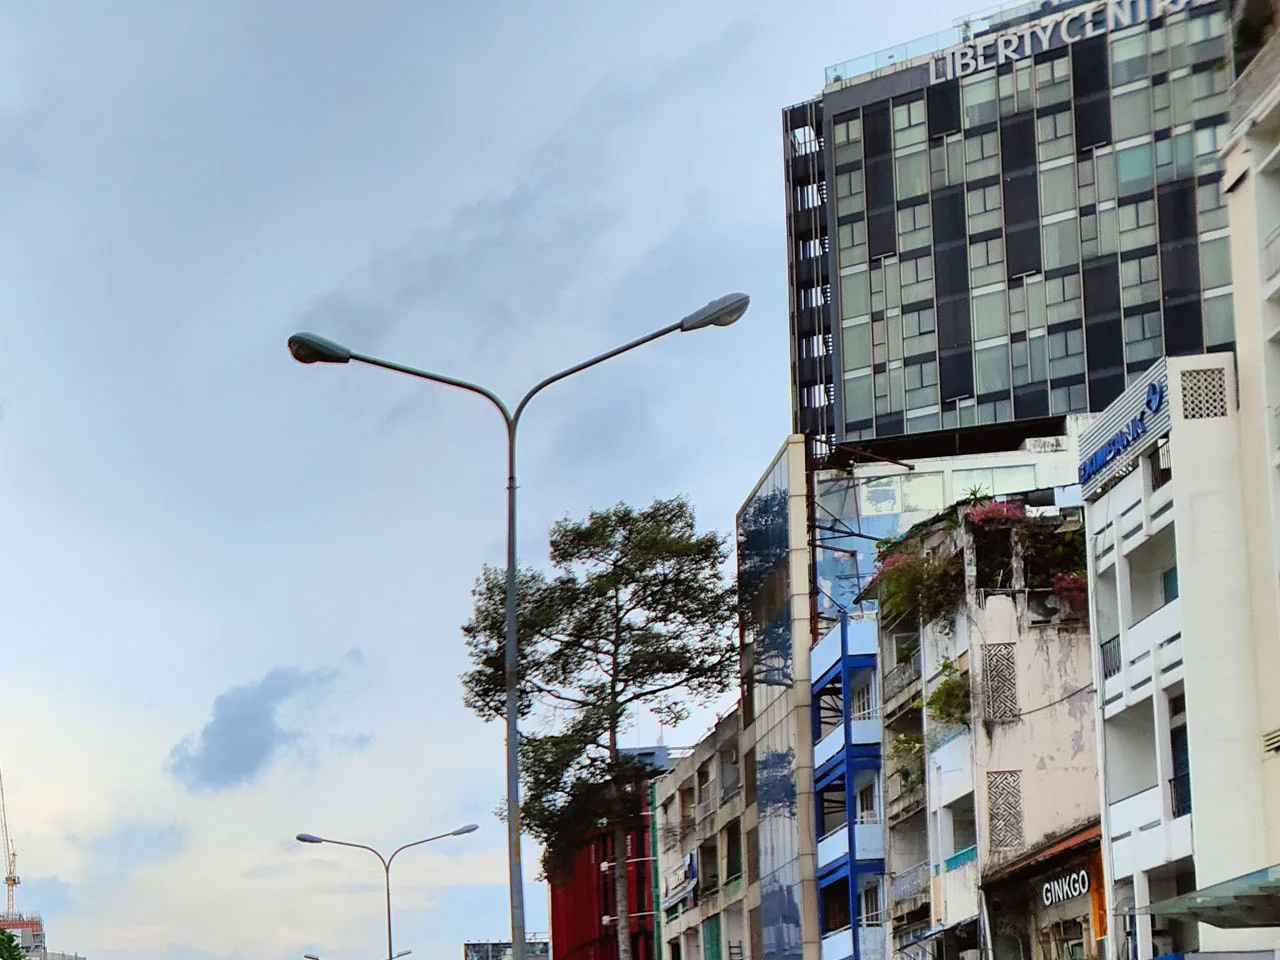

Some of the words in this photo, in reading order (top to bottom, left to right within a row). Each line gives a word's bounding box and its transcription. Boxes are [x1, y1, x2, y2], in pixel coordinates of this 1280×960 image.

[929, 23, 1055, 85] LIBERTY
[1079, 411, 1147, 485] EXIMBANK
[1043, 870, 1089, 905] GINKGO
